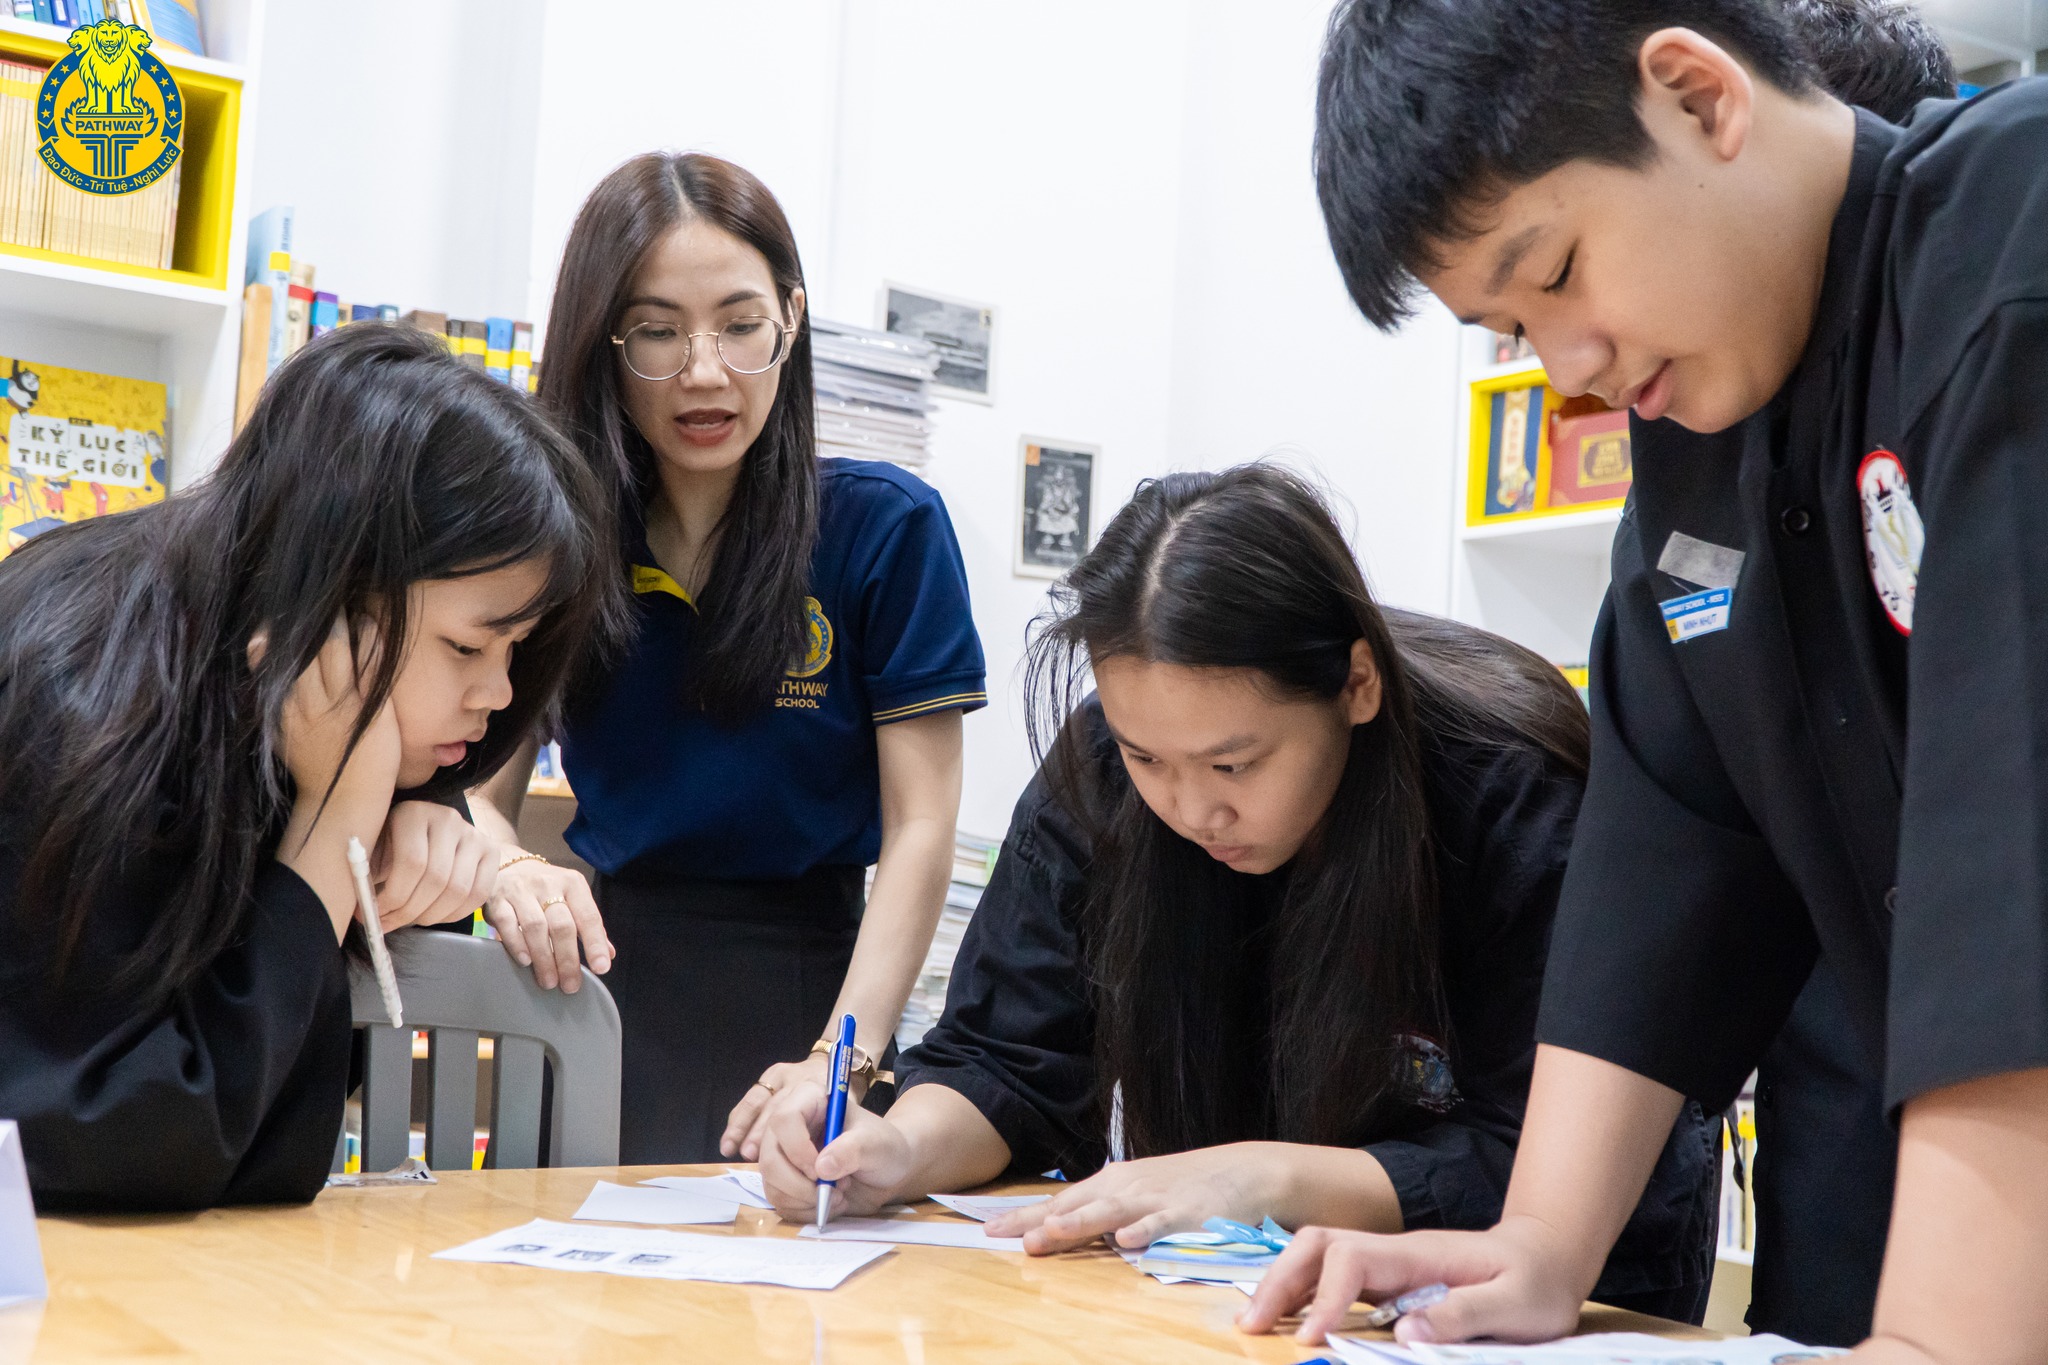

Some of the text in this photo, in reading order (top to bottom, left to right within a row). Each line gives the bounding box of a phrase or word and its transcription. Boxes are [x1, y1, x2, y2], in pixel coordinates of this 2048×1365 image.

[79, 433, 127, 457] LỤC
[18, 447, 137, 480] THẾ GIỚI
[776, 680, 829, 697] THWAY
[775, 698, 820, 709] SCHOOL
